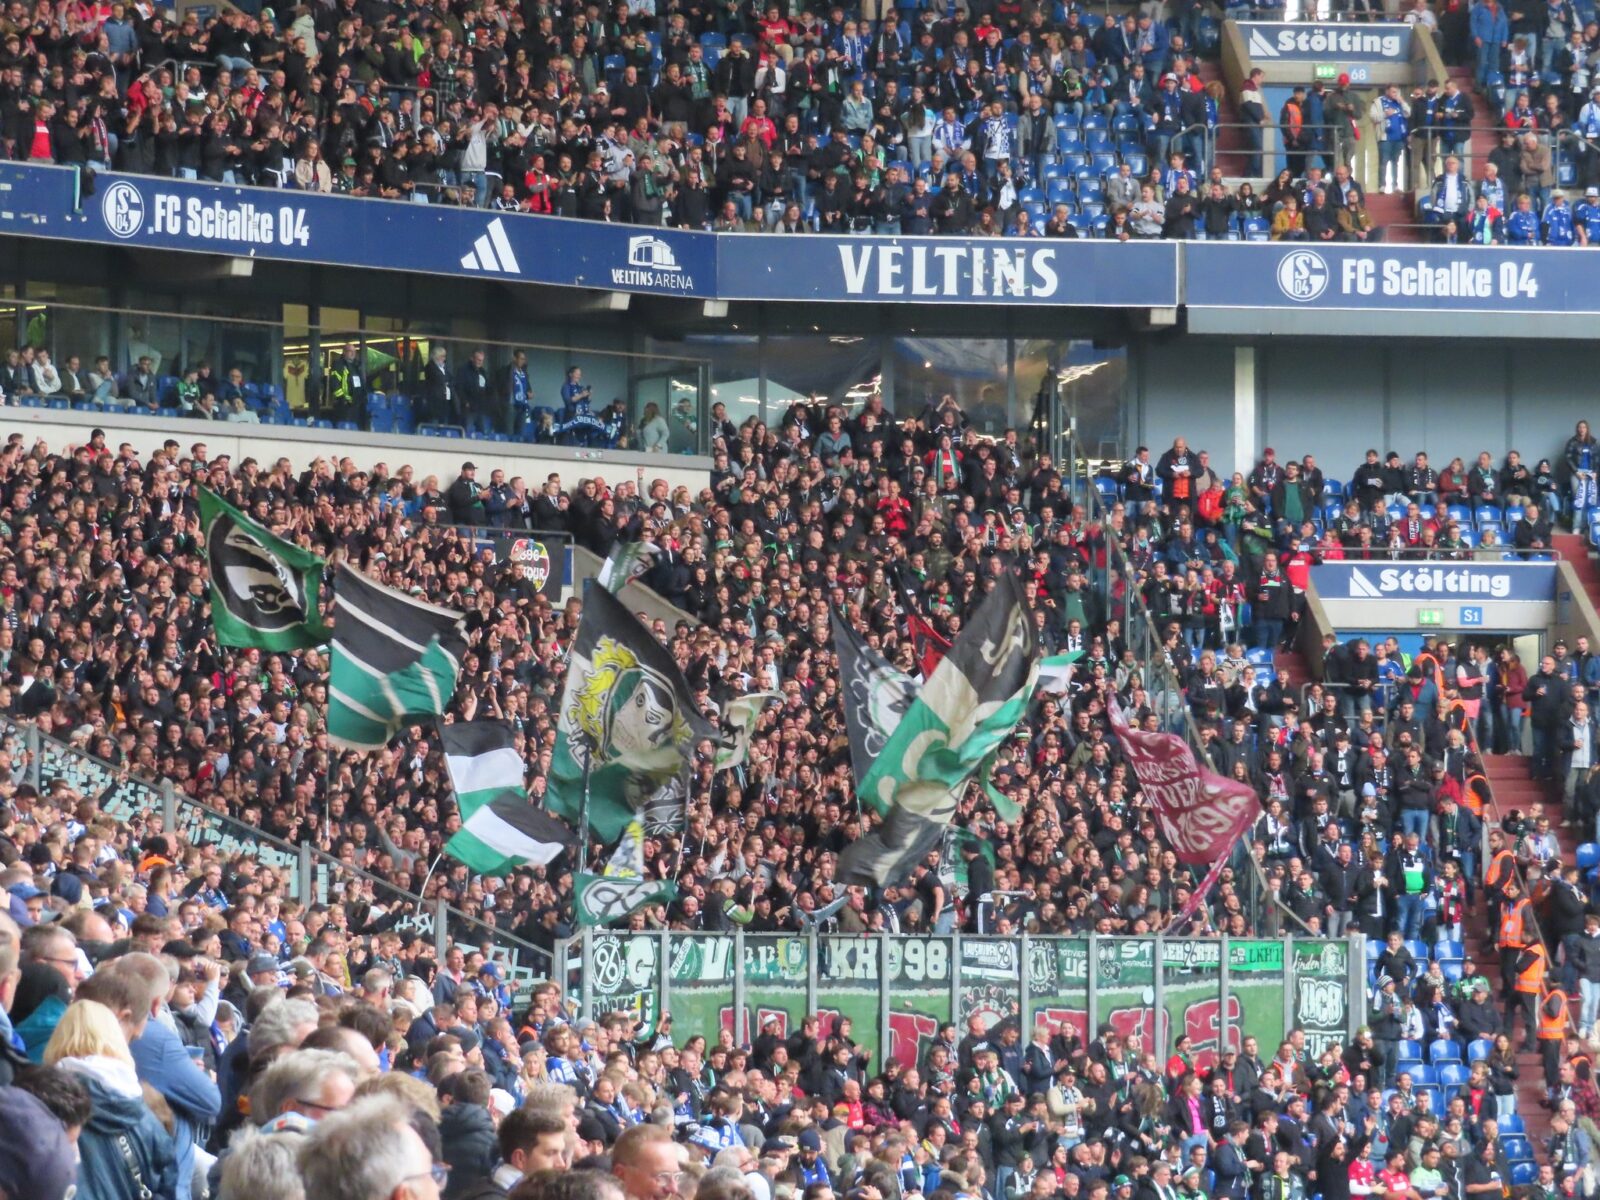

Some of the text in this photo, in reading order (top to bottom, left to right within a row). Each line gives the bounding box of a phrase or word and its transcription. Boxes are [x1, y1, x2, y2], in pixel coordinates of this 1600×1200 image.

[1277, 28, 1401, 57] Stölting
[1351, 67, 1367, 81] 68
[153, 193, 309, 247] FC Schalke 04
[611, 267, 694, 290] VELTINS ARENA
[838, 244, 1059, 298] VELTINS
[1341, 258, 1539, 299] FC Schalke 04
[1379, 567, 1511, 597] Stölting
[1463, 609, 1479, 622] S1
